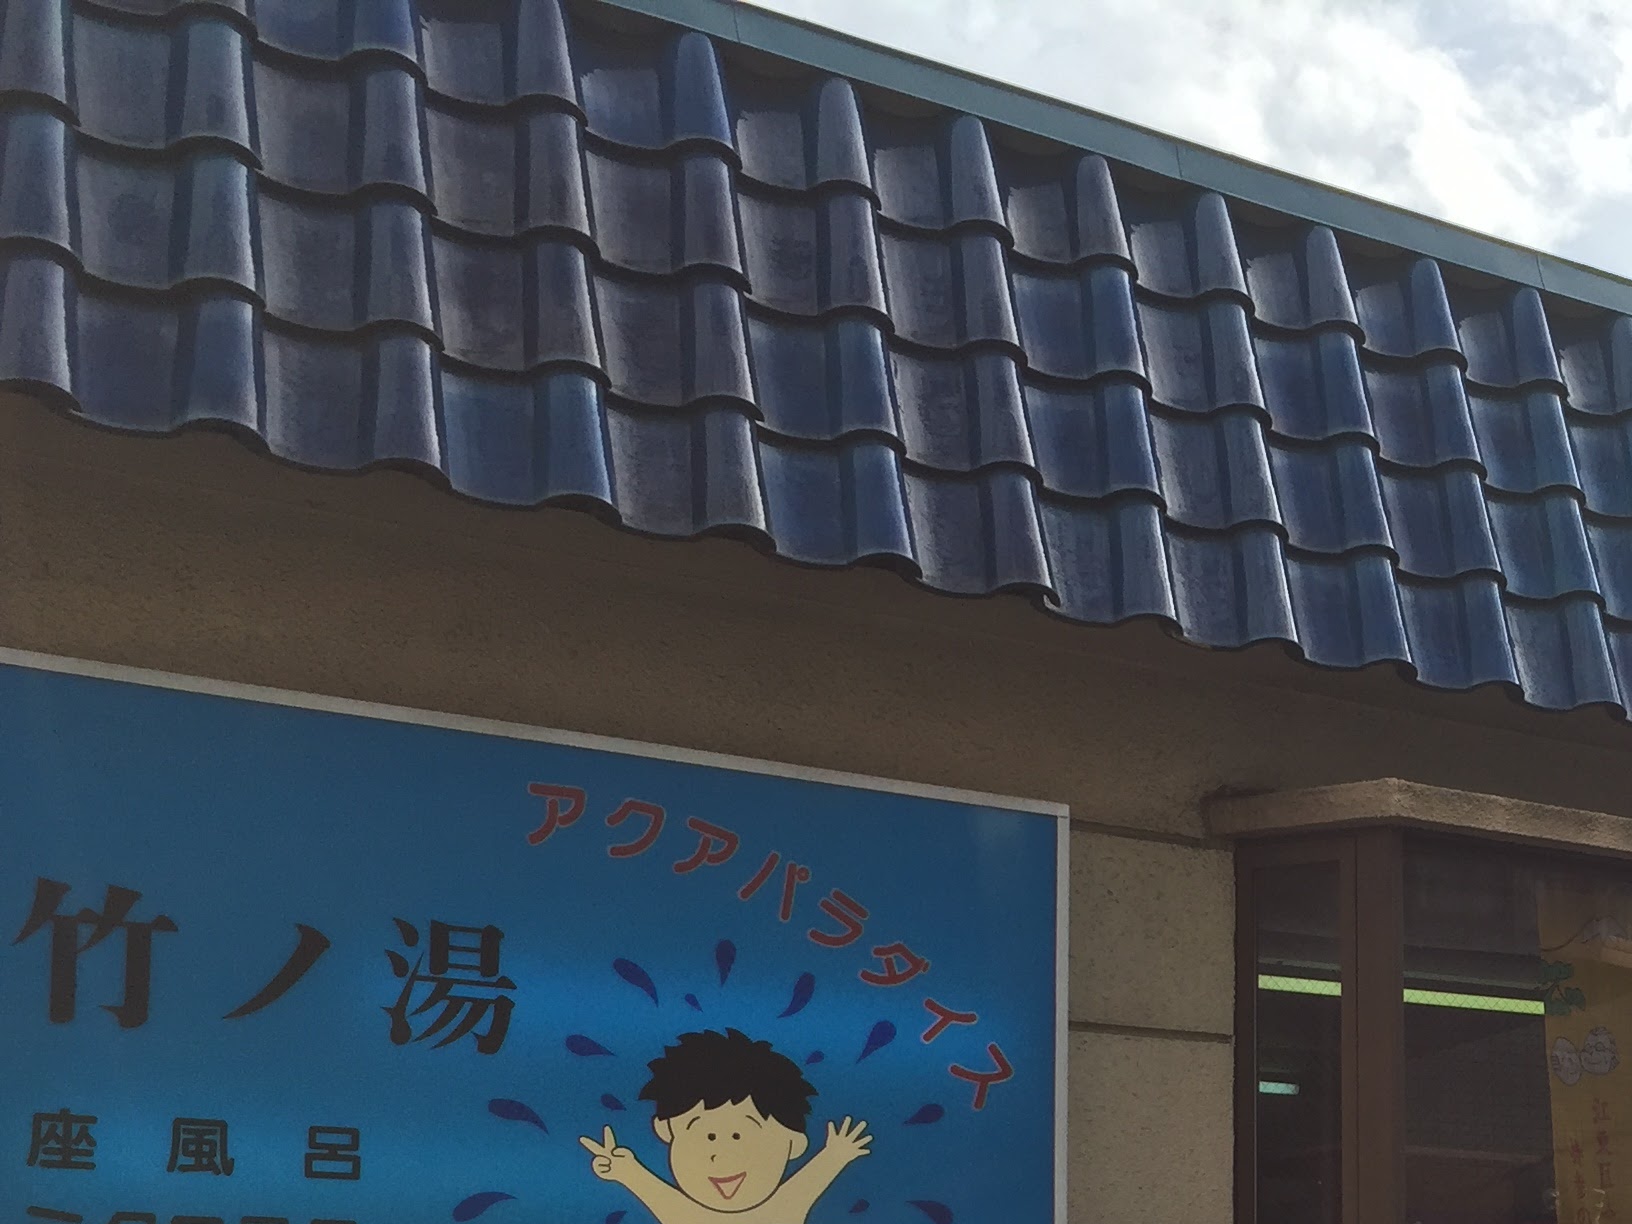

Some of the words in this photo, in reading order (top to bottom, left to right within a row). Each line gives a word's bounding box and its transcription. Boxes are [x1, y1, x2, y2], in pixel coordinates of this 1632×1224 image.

[10, 876, 519, 1057] 竹ノ湯
[525, 781, 1015, 1111] アクアパラダイス
[26, 1108, 362, 1181] 座風呂
